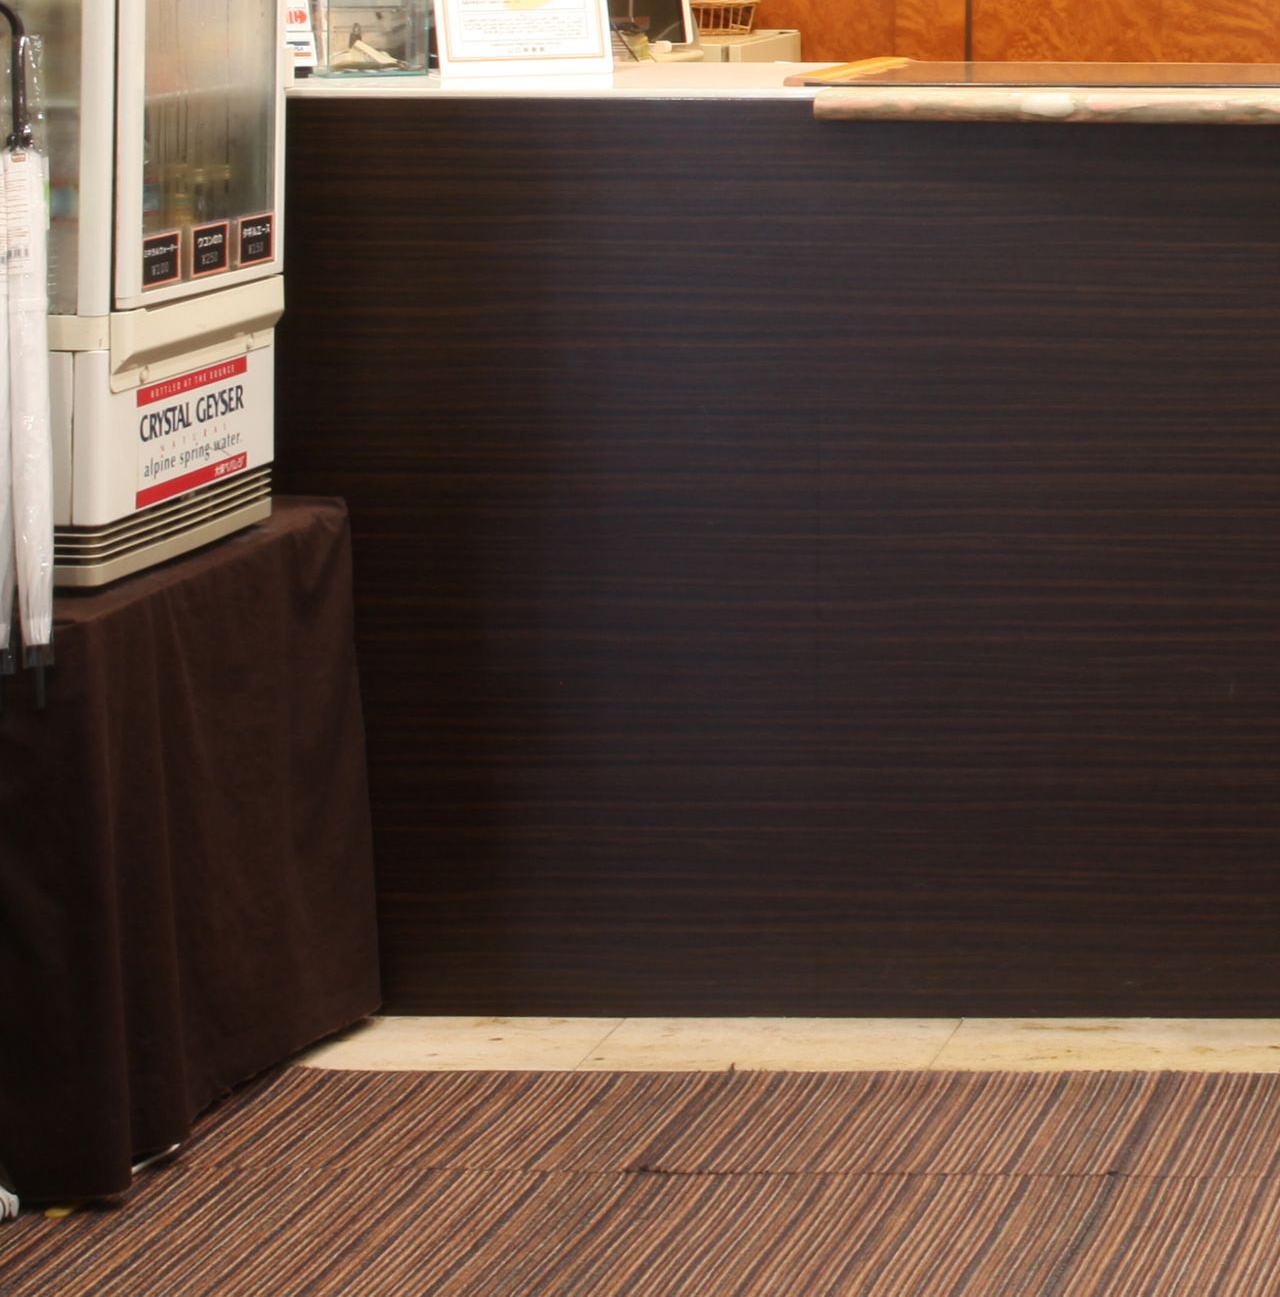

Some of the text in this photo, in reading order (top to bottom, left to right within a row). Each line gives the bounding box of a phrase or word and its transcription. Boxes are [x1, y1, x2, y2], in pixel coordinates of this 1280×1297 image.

[150, 364, 236, 399] BOTTLED AT THE SOURCE
[140, 385, 244, 442] CRYSTAL GEYSER
[160, 422, 228, 452] NATURAL
[143, 455, 176, 479] alpine
[179, 442, 210, 468] spring
